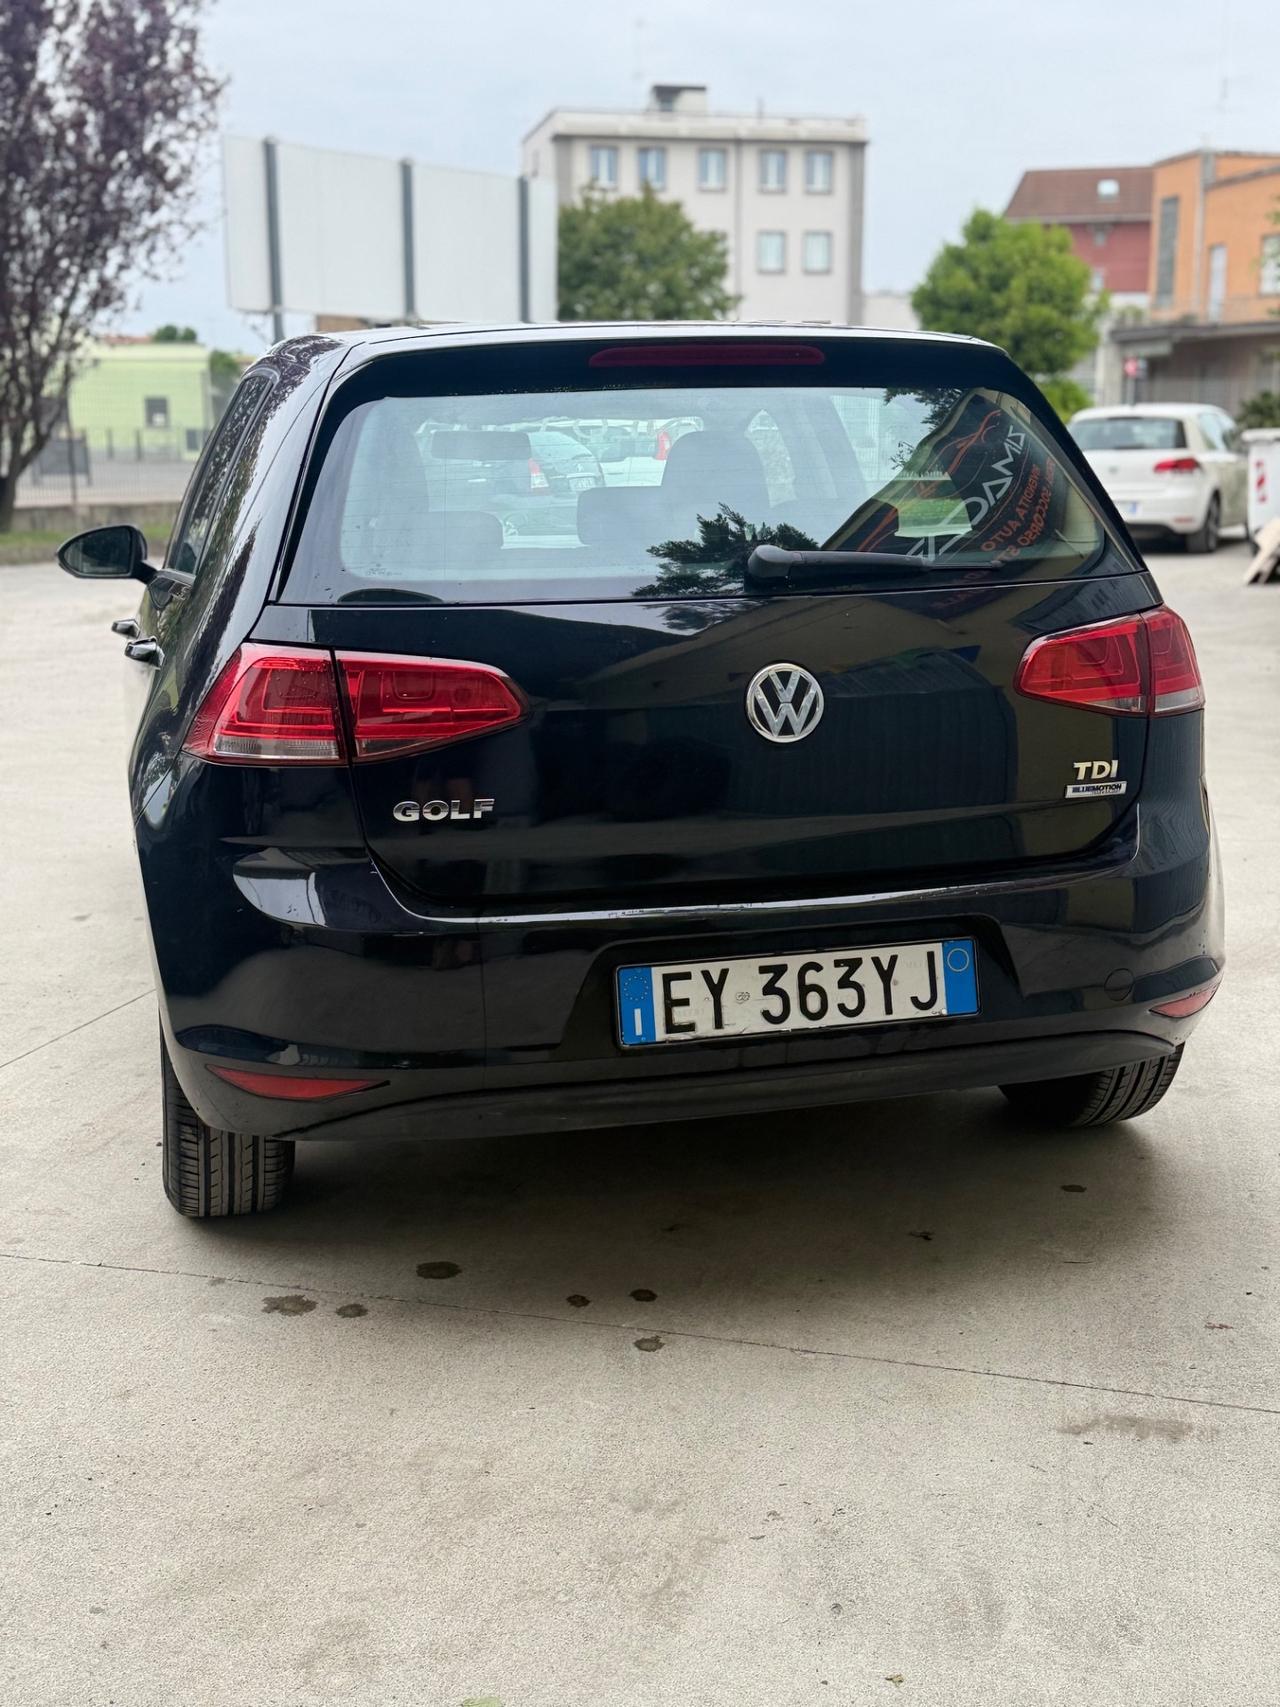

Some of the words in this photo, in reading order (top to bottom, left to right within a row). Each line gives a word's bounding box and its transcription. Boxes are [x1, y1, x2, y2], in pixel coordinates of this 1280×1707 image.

[1073, 760, 1119, 780] TDI
[393, 799, 495, 822] GOLF
[662, 968, 729, 1034] EY
[758, 951, 939, 1025] 363YJ
